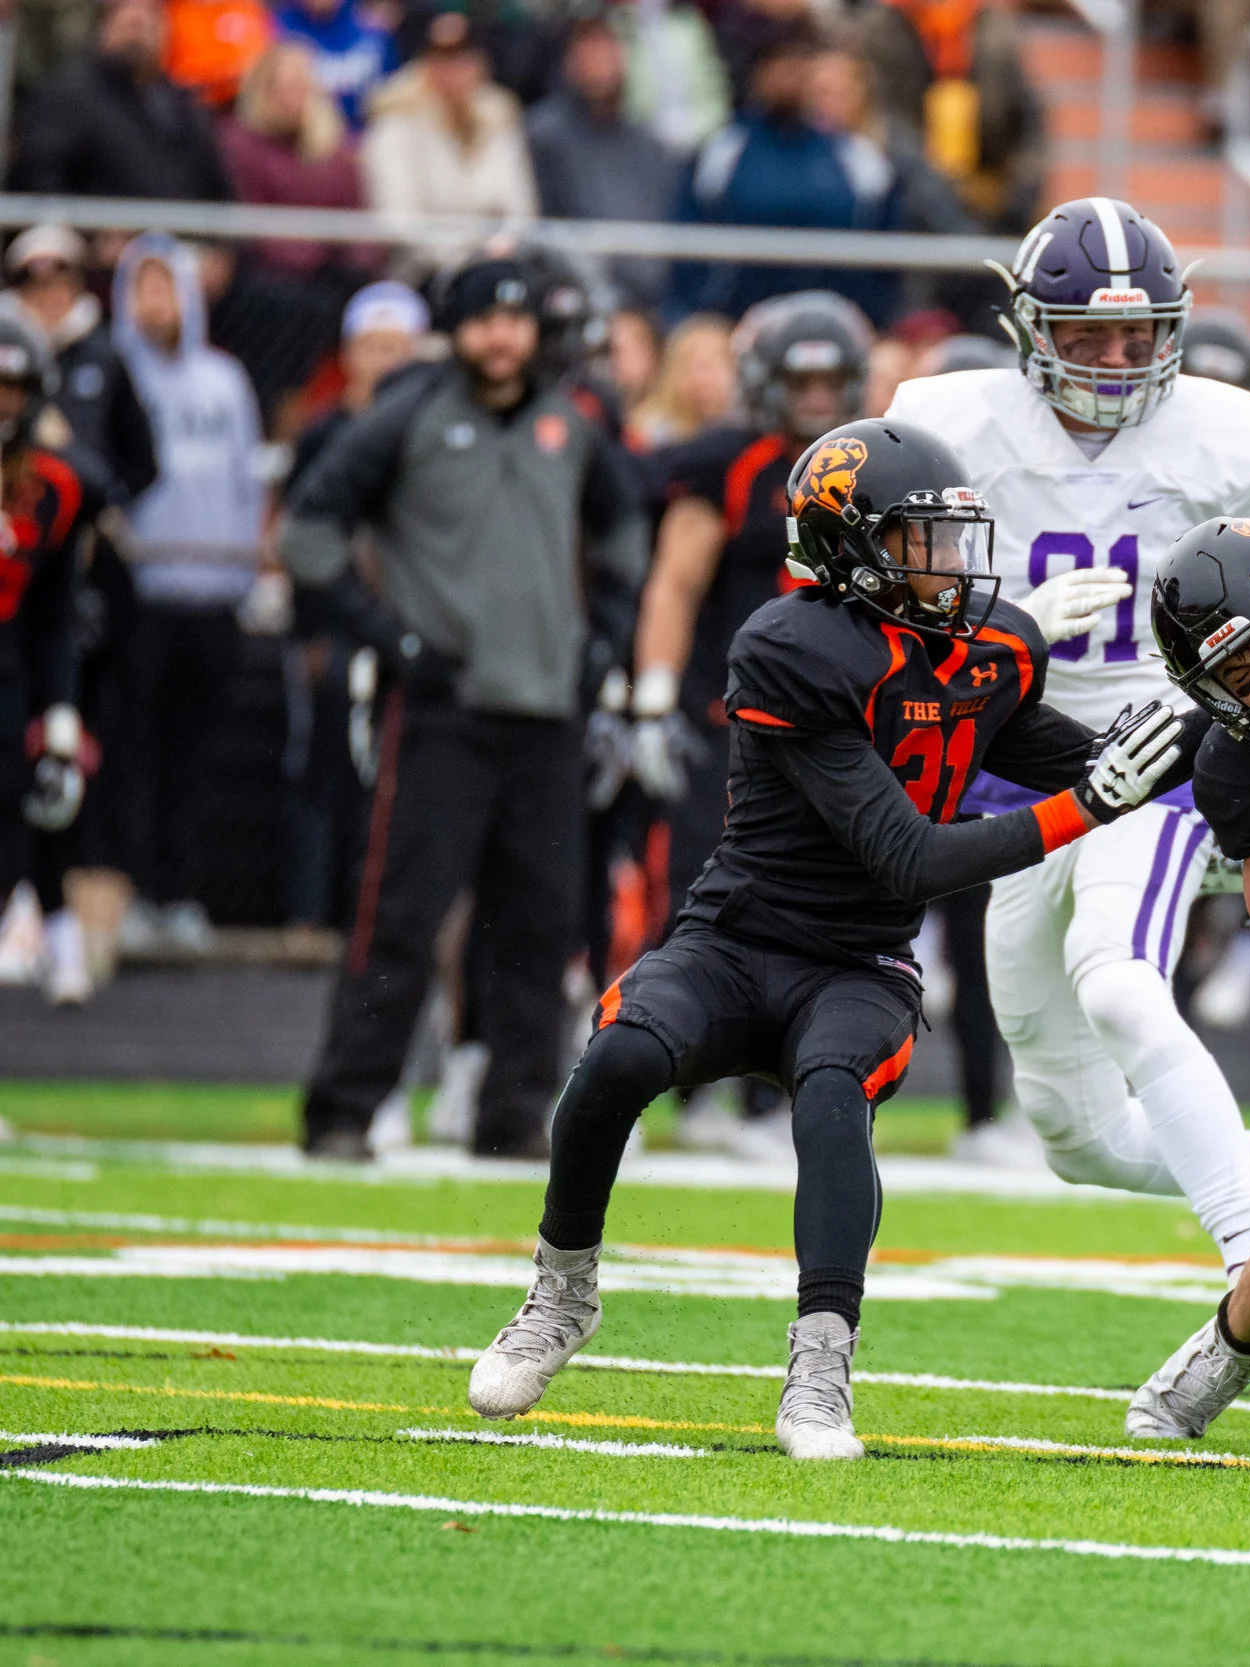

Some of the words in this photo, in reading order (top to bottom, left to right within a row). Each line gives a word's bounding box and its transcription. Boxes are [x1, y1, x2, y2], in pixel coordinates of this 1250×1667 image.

[1100, 293, 1143, 303] Riddell
[1028, 531, 1139, 663] 91
[1206, 623, 1235, 648] VILLE
[902, 701, 941, 720] THE
[949, 696, 991, 717] VILLE
[1207, 698, 1242, 713] ddell
[890, 719, 975, 825] 31
